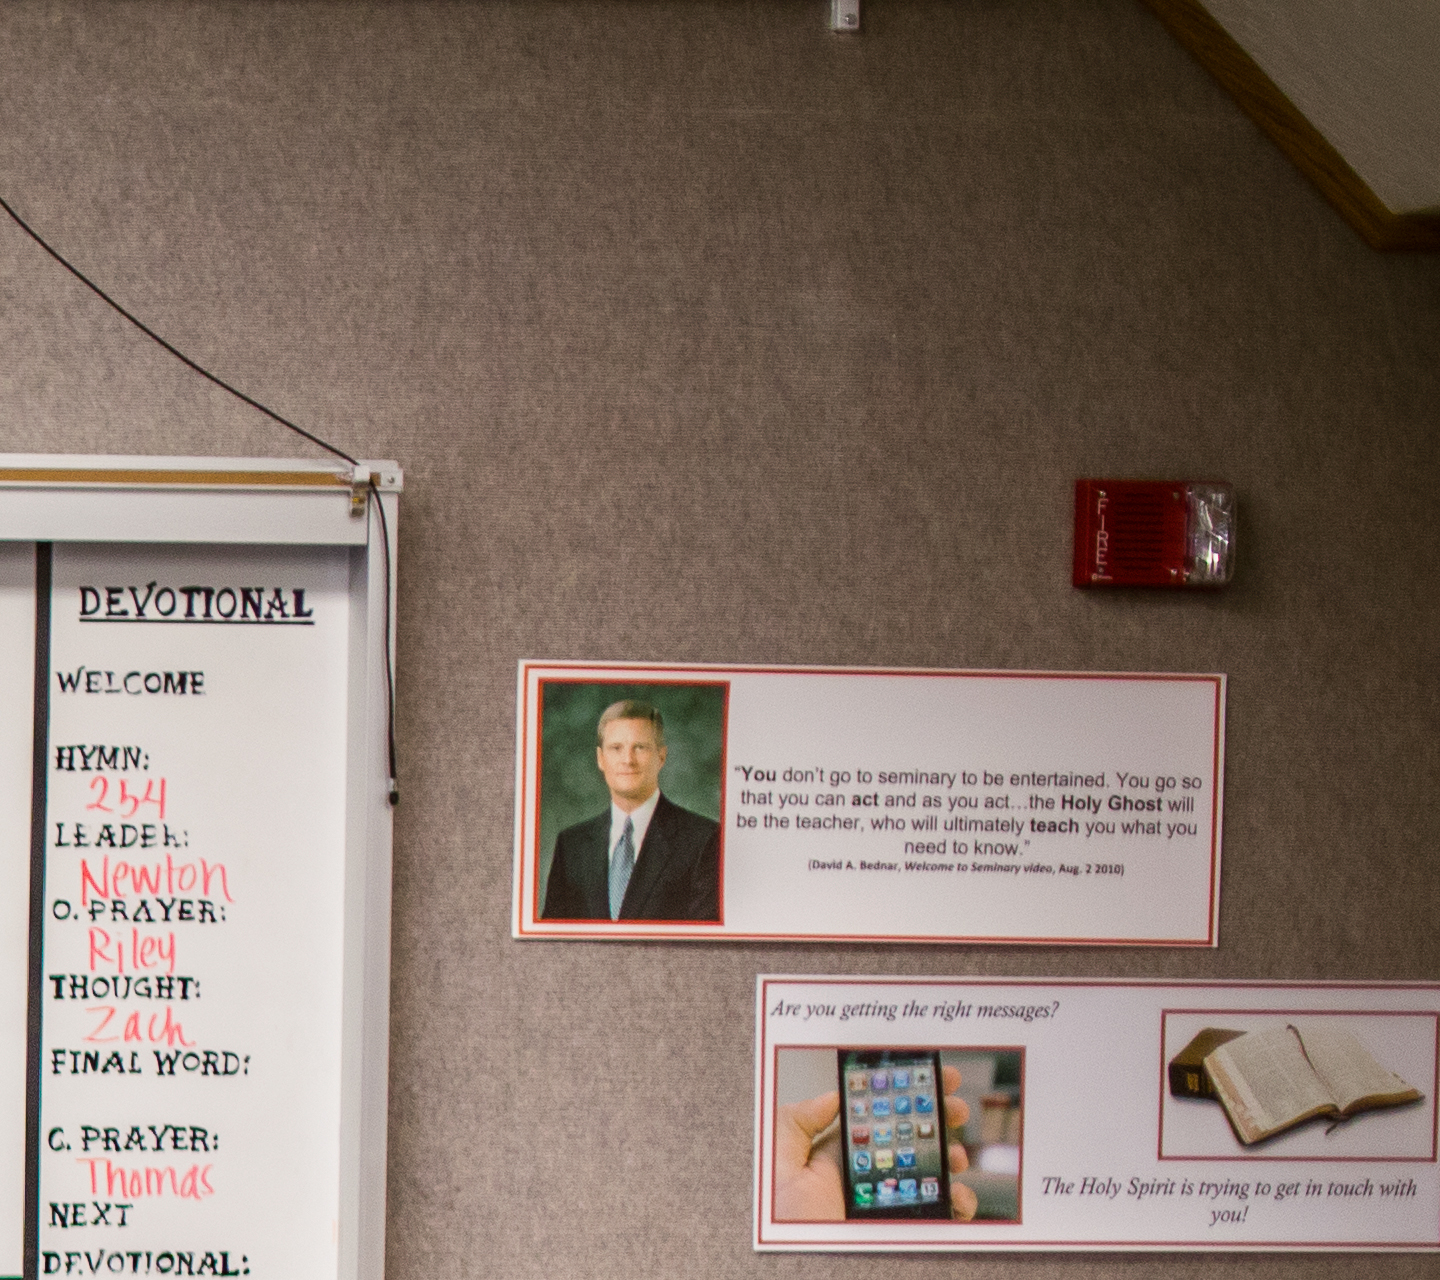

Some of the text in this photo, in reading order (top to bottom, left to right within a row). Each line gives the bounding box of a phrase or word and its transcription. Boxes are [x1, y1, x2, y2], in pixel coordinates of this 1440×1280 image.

[1096, 497, 1110, 566] FIRE
[78, 581, 314, 618] DEVOTIONAL
[56, 665, 205, 696] WELCOME
[55, 744, 149, 772] HYMN:
[781, 766, 825, 783] don't
[829, 770, 852, 788] go
[856, 768, 873, 783] to
[877, 768, 957, 789] seminary
[961, 769, 978, 786] to
[982, 770, 1005, 787] be
[1008, 770, 1109, 788] entertained.
[1115, 770, 1150, 789] You
[1154, 775, 1177, 794] go
[1181, 775, 1203, 789] so
[86, 775, 167, 820] 254
[740, 790, 773, 806] that
[778, 792, 810, 809] you
[814, 793, 846, 807] can
[850, 791, 880, 807] act
[884, 792, 917, 808] and
[921, 794, 943, 809] as
[947, 794, 979, 813] you
[1060, 793, 1101, 815] Holy
[1107, 794, 1163, 813] Ghost
[1167, 795, 1195, 812] will
[736, 812, 1198, 839] be the teacher, who will ultimately teach you what you
[903, 839, 948, 856] need
[952, 840, 969, 856] to
[80, 854, 232, 907] Newton
[807, 859, 1125, 877] (David A. Bednar, Welcome to Seminary video, Aug. 2 2010)
[84, 895, 226, 924] PRAYER:
[87, 926, 176, 972] Riley
[48, 974, 201, 1001] THOUGHT:
[770, 999, 1061, 1024] Are you getting the right messages?
[85, 1005, 196, 1048] Zach
[51, 1048, 251, 1077] FINAL WORD:
[47, 1124, 219, 1153] C. PRAYER:
[77, 1157, 215, 1200] Thomas
[1042, 1174, 1417, 1201] The Holy Spirit is trying to get in touch with
[48, 1201, 133, 1230] NEXT
[1208, 1205, 1250, 1228] you!
[41, 1248, 251, 1278] DEVOTIONAL:
